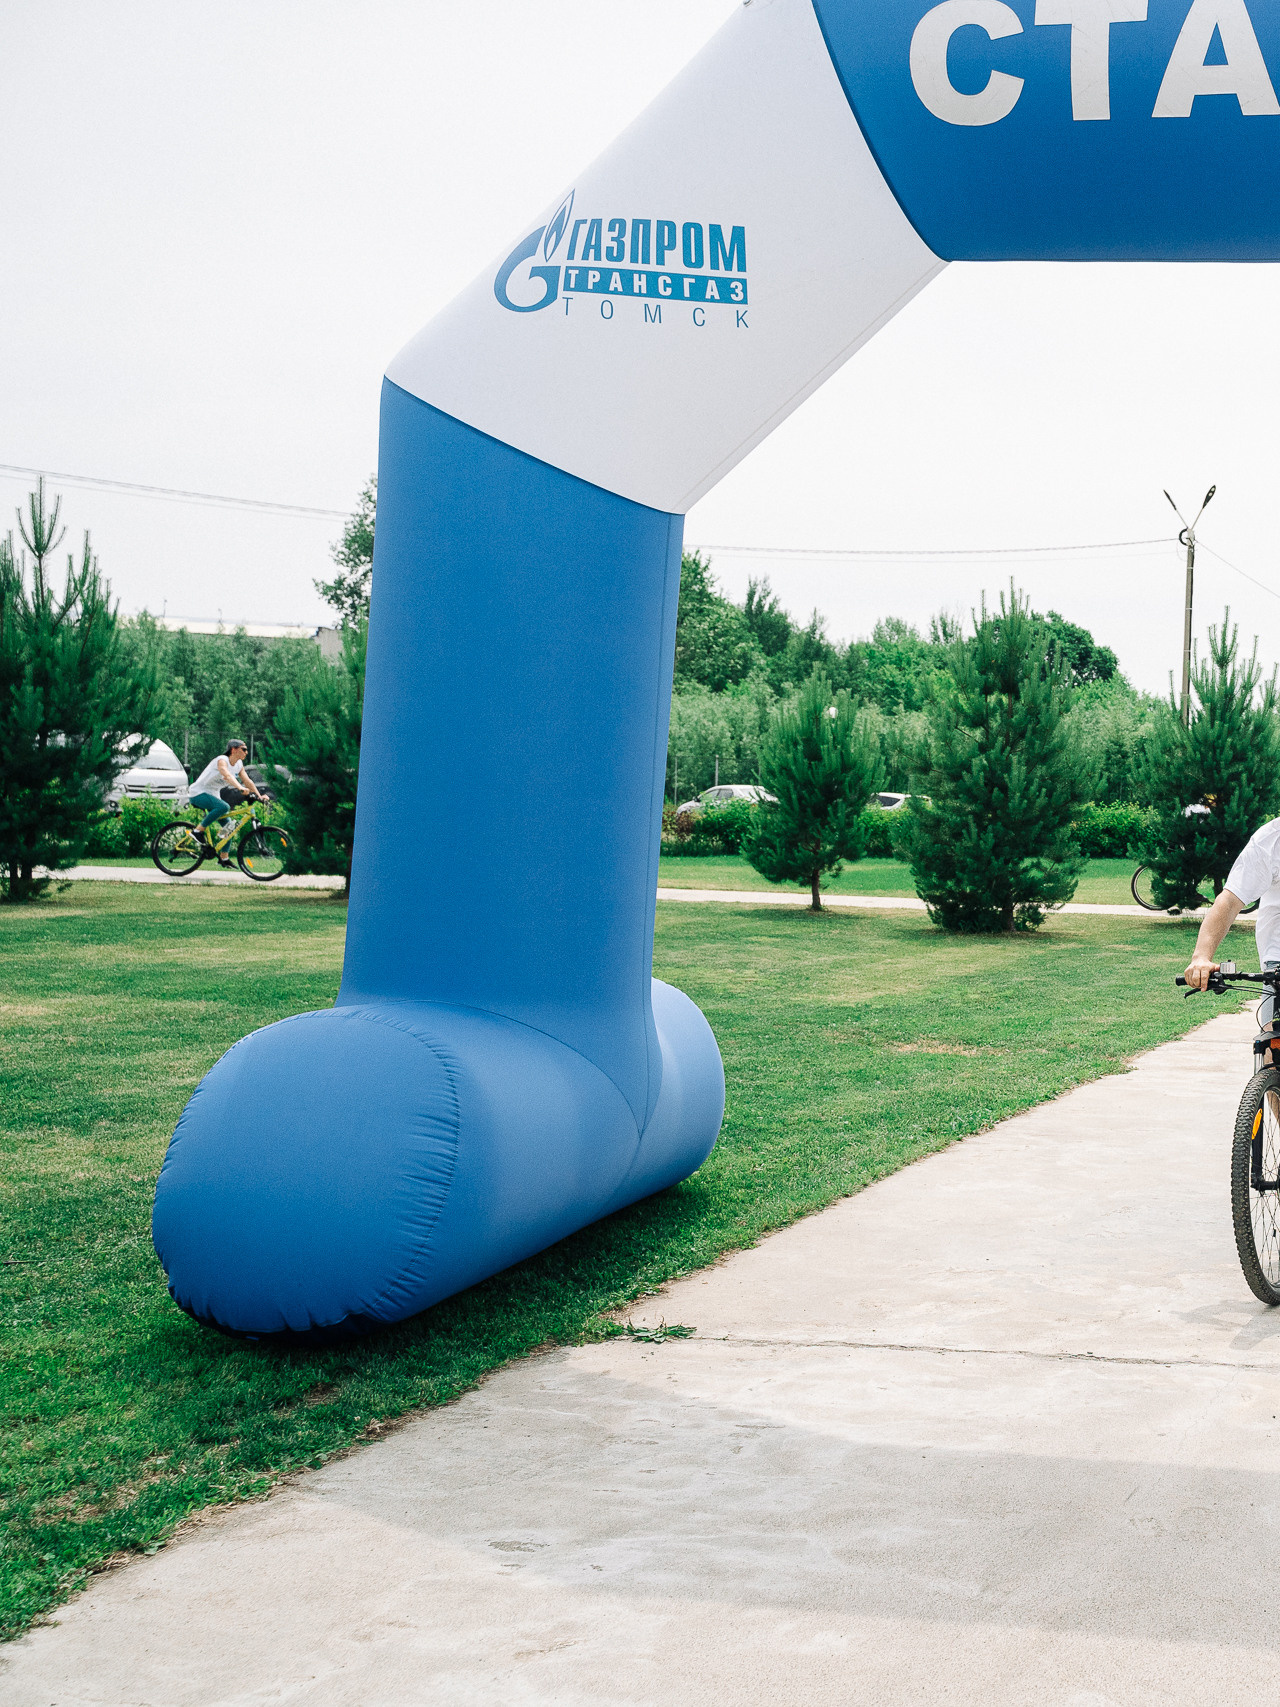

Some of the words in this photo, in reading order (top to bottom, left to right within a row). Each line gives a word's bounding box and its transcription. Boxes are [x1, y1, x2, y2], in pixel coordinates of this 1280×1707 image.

[566, 218, 747, 273] ГАЗПРОМ
[567, 269, 745, 302] ТРАНСГАЗ
[562, 297, 749, 328] ТОМСК
